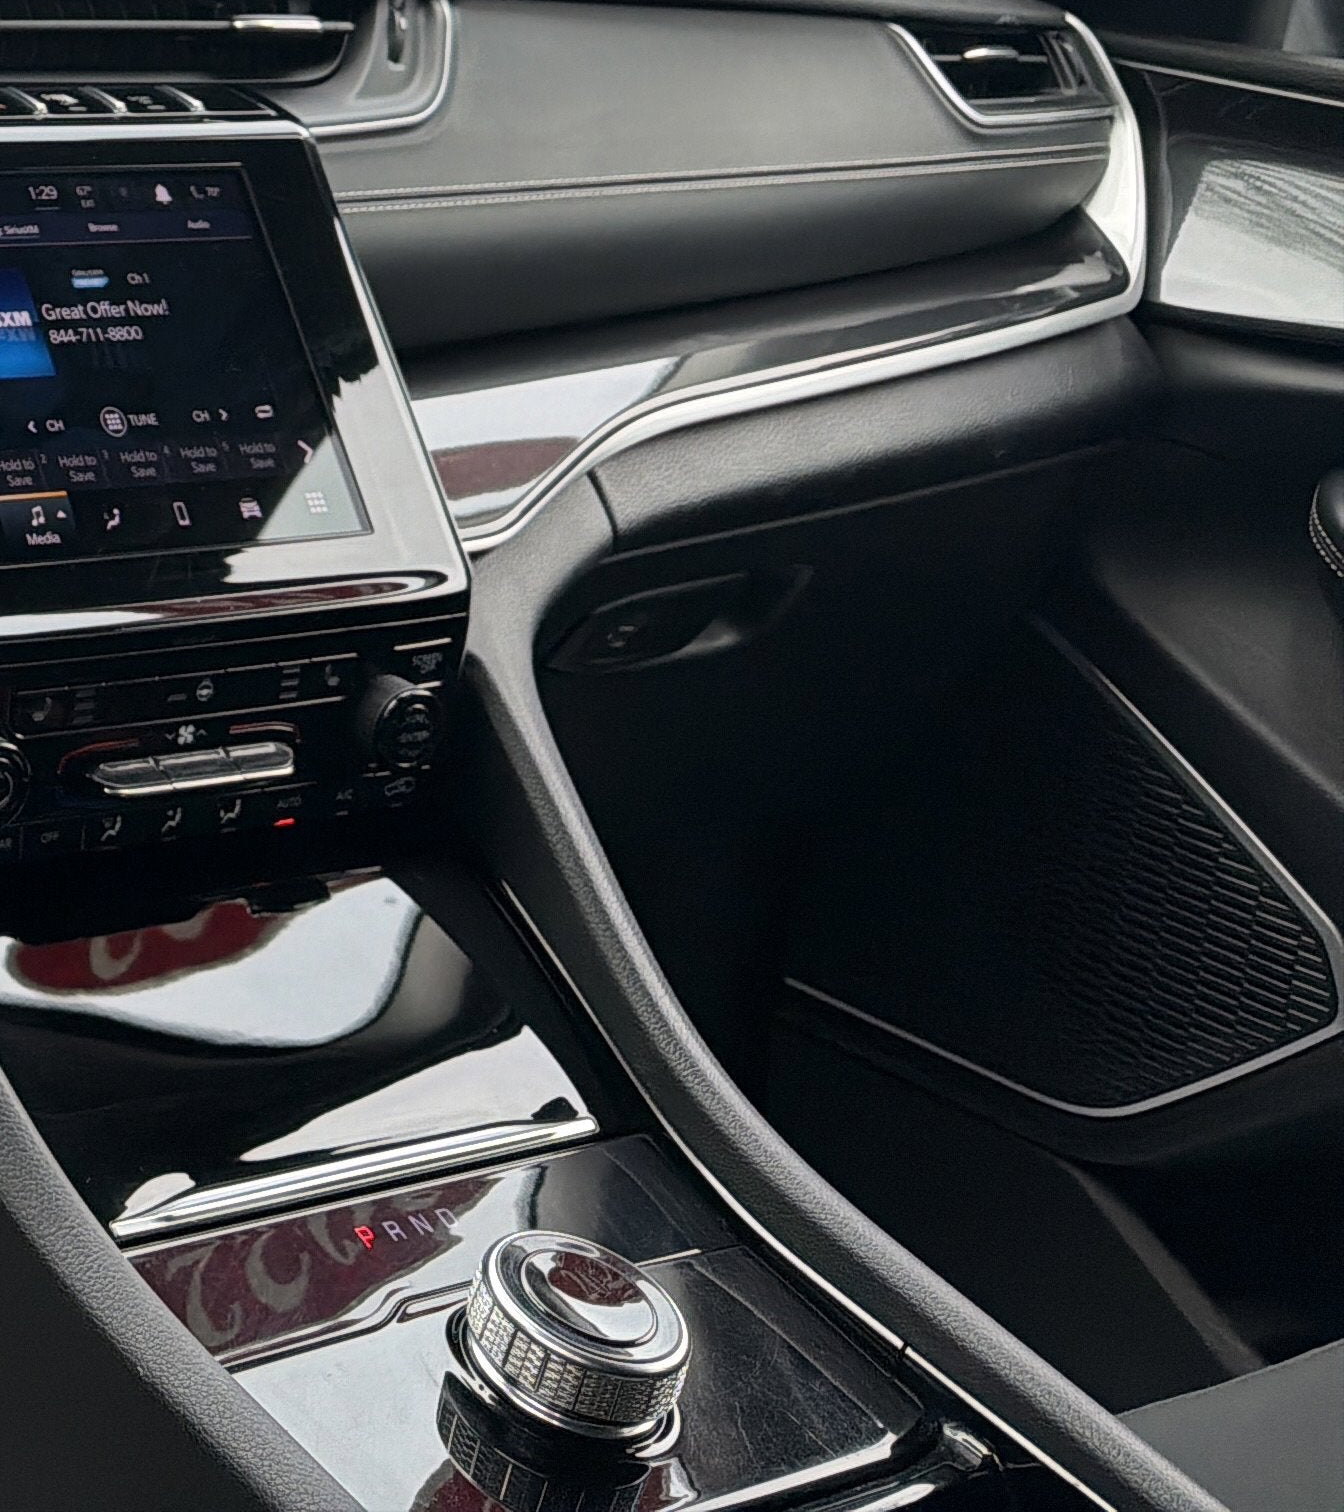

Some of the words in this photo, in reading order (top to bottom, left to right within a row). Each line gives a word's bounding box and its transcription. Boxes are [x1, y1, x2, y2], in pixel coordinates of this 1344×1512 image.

[29, 185, 58, 200] 1:29
[127, 272, 143, 285] Ch
[42, 302, 86, 322] Great
[87, 300, 127, 320] Offer
[128, 299, 169, 317] Now!
[48, 325, 144, 344] 844-711-8800
[127, 412, 160, 427] TUNE
[192, 410, 211, 423] CH
[46, 420, 65, 432] CH
[180, 446, 204, 459] Hold
[205, 445, 217, 457] to
[239, 443, 262, 455] Hold
[263, 442, 275, 453] to
[58, 455, 83, 468] Hold
[84, 454, 97, 466] to
[120, 450, 145, 463] Hold
[146, 450, 157, 462] to
[250, 457, 275, 469] Save
[23, 458, 36, 471] to
[191, 461, 216, 473] Save
[69, 471, 96, 483] Save
[131, 466, 157, 478] Save
[6, 475, 33, 488] Save
[26, 531, 61, 546] Media
[354, 1225, 375, 1250] P
[382, 1220, 408, 1242] R
[408, 1213, 434, 1235] N
[434, 1208, 459, 1229] D
